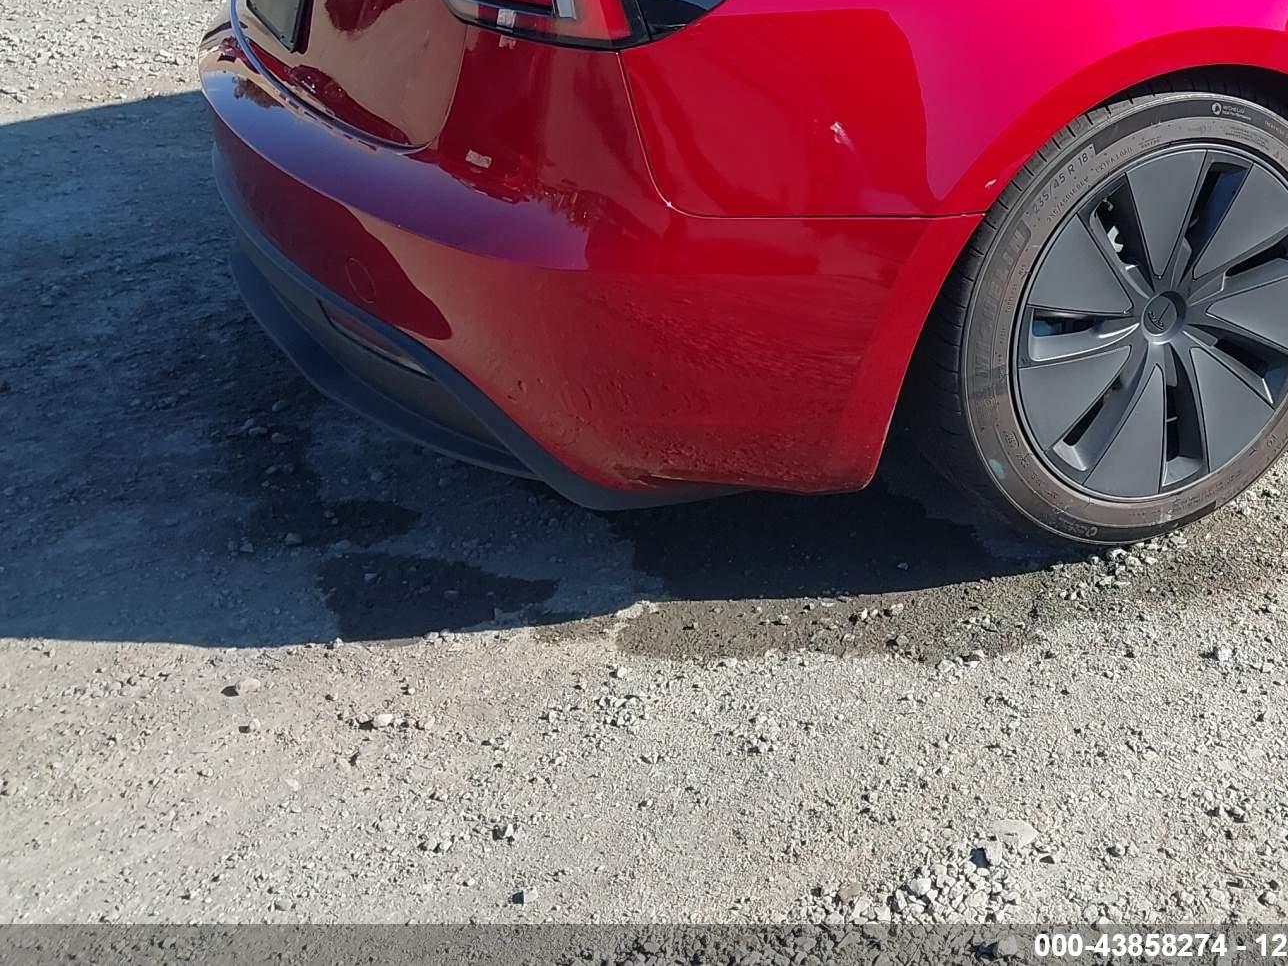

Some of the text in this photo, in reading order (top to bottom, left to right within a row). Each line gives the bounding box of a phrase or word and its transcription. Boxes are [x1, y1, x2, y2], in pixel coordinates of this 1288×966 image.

[1032, 152, 1089, 213] 235/45 R 18
